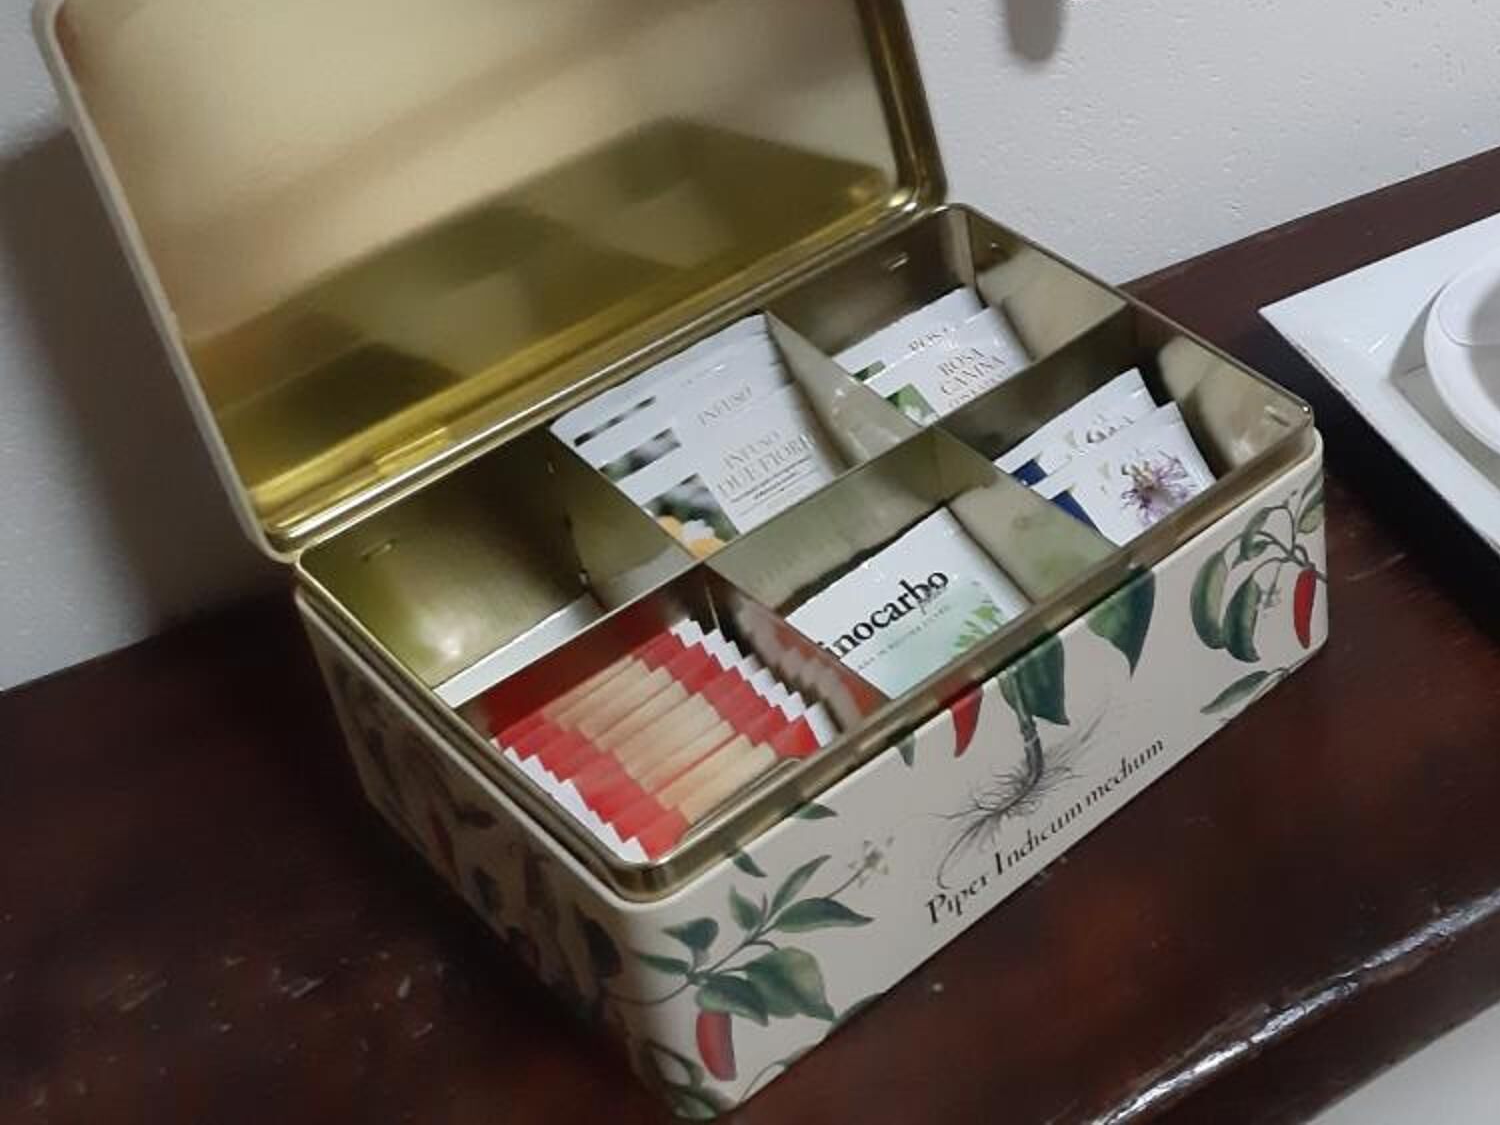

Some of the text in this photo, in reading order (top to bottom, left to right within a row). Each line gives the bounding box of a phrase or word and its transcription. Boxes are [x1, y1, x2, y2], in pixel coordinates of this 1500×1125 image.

[817, 571, 949, 659] inocarbo
[925, 739, 1166, 924] Piper Indicum medium
